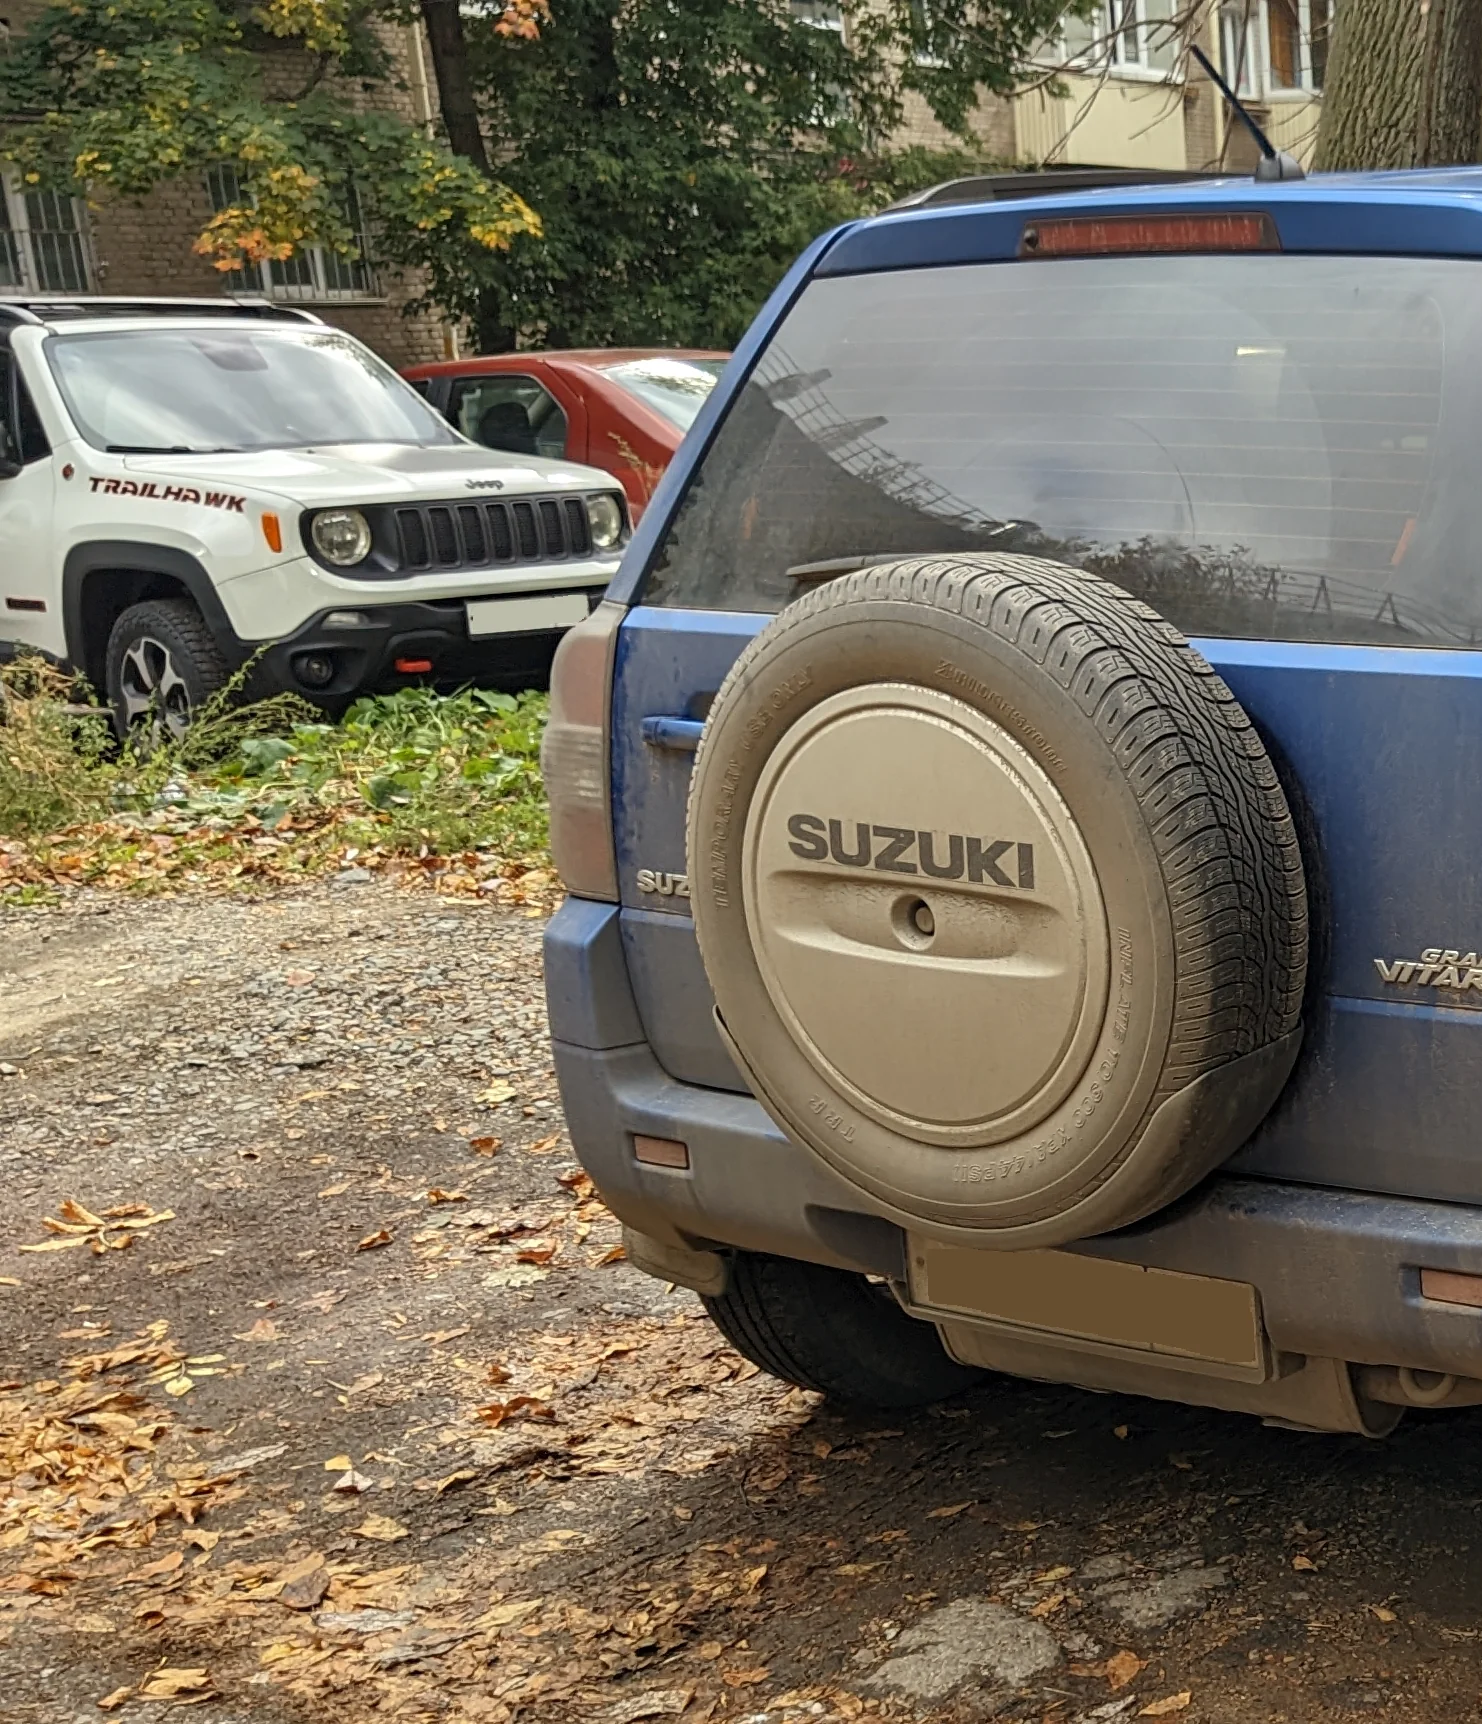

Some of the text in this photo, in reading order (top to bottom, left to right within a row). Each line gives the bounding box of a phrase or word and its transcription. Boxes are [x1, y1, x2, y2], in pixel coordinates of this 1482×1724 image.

[89, 476, 247, 513] TRAILHAWK
[464, 478, 504, 490] Jeep
[787, 813, 1035, 890] SUZUKI
